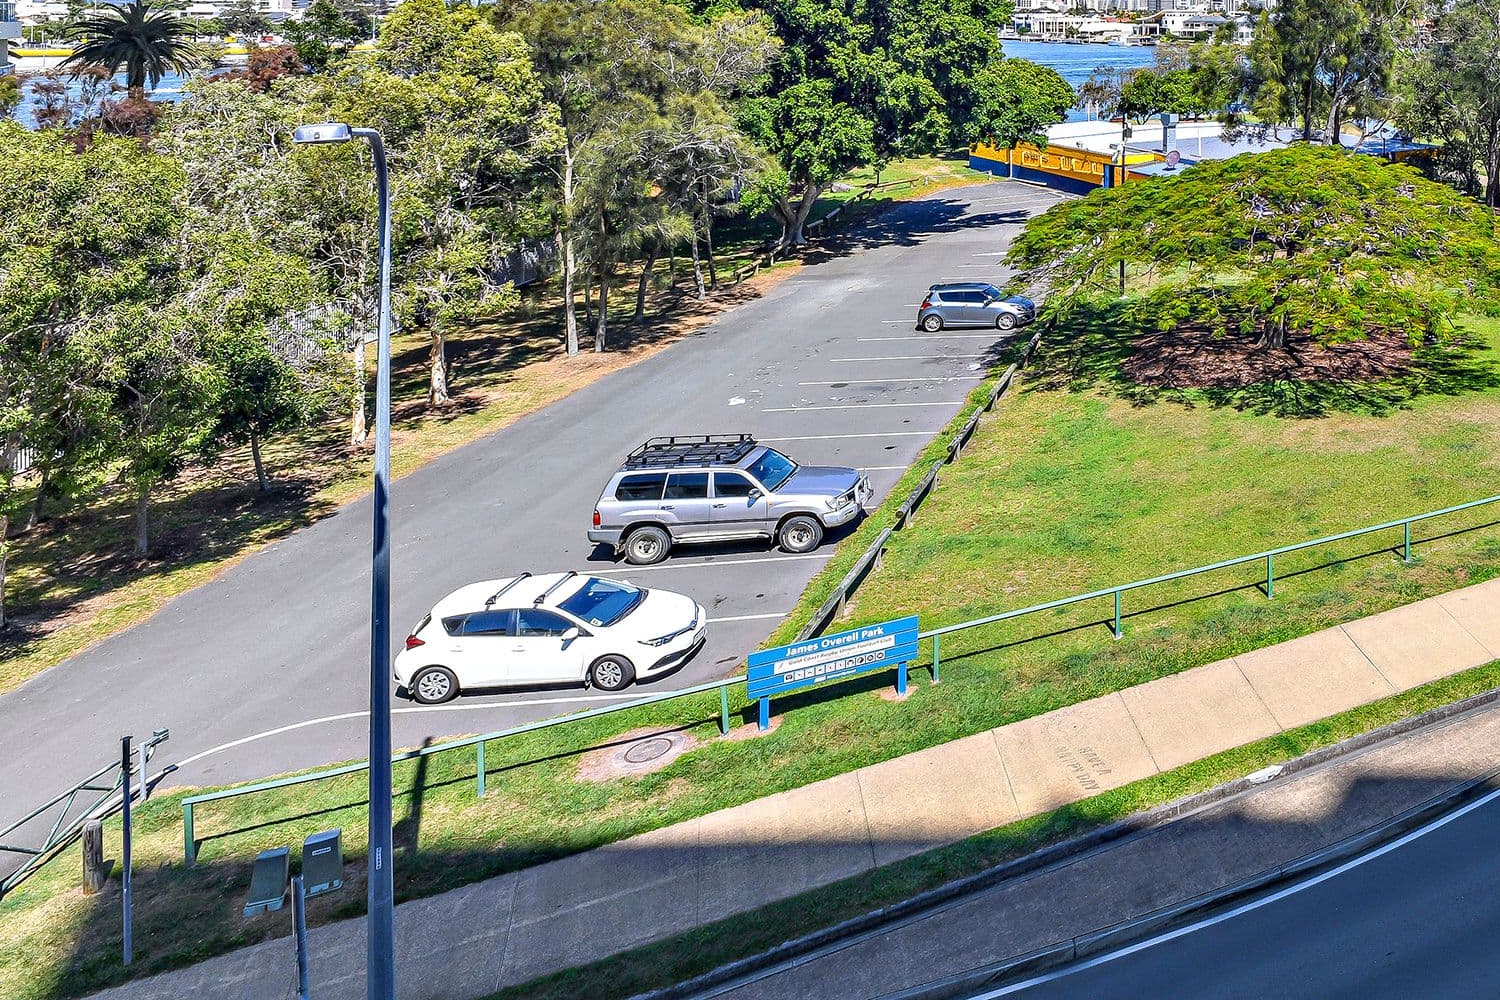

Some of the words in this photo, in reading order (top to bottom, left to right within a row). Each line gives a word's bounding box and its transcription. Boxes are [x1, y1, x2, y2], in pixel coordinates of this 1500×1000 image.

[787, 642, 818, 657] James
[822, 632, 858, 648] Overell
[862, 626, 884, 639] Park
